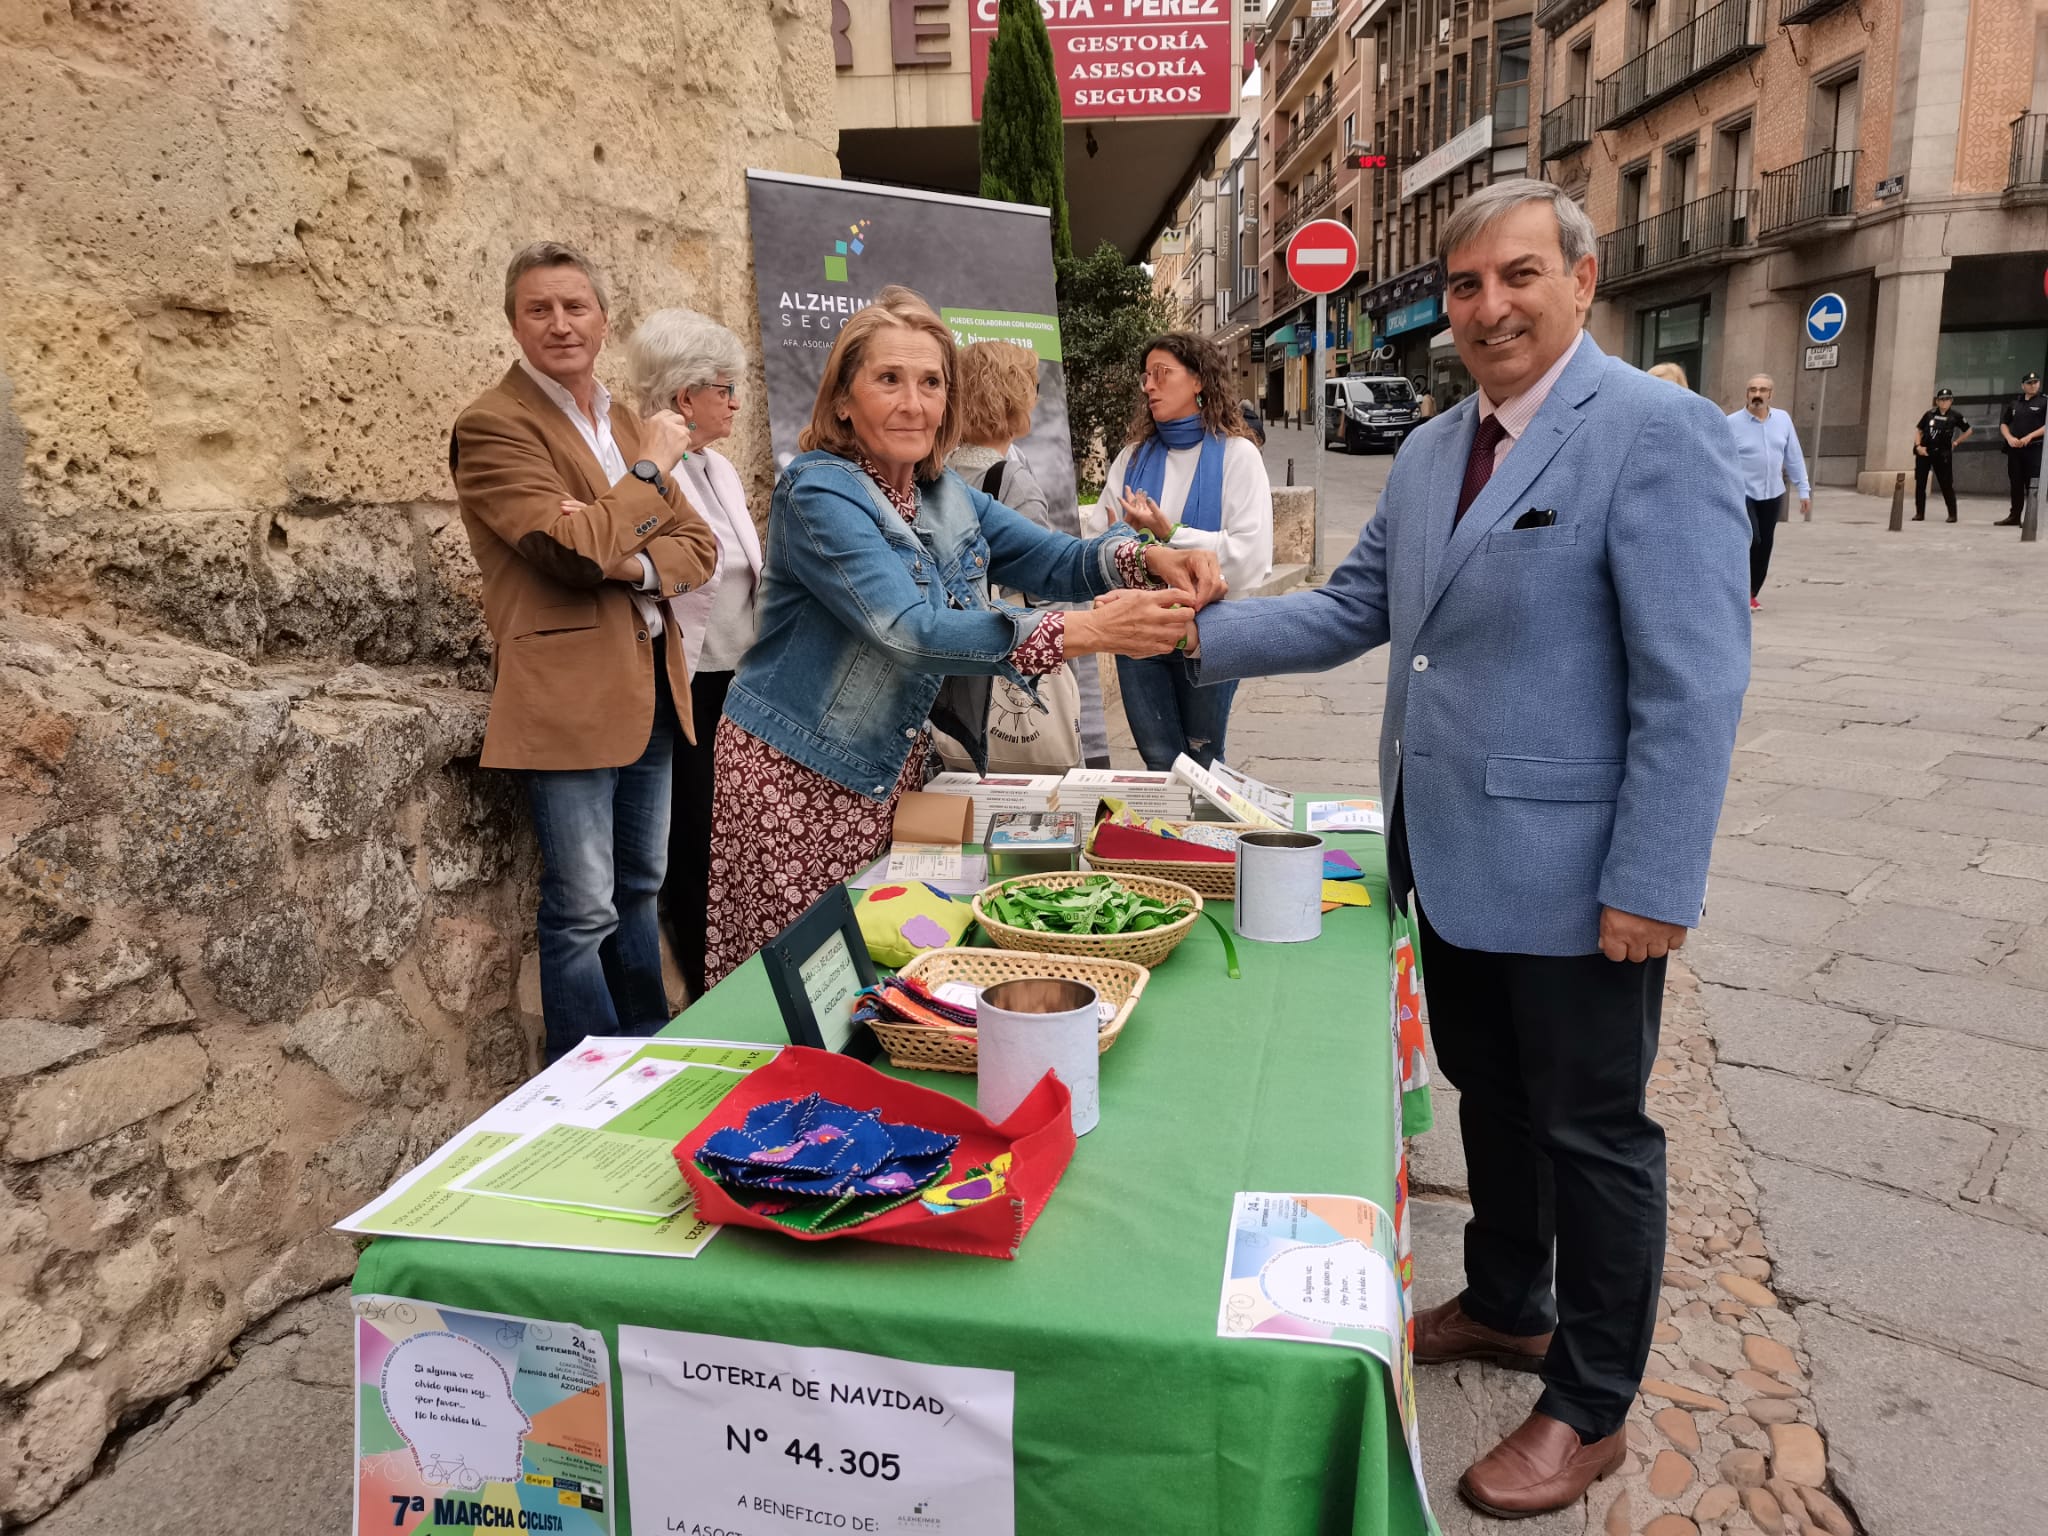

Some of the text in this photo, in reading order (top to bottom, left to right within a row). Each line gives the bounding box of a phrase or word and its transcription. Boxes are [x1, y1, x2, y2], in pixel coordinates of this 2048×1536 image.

[977, 0, 1094, 21] CSTA
[1067, 33, 1208, 53] GESTORÍA
[1069, 60, 1206, 80] ASESORÍA
[1074, 86, 1202, 106] SEGUROS
[779, 291, 875, 314] ALZHEIM
[950, 317, 974, 325] PUEDES
[974, 318, 1011, 328] COLABORAR
[1011, 320, 1025, 328] CON
[989, 726, 1040, 744] grateful heart
[535, 1345, 580, 1357] SEPTIEMBRE
[572, 1336, 586, 1350] 24
[414, 1364, 474, 1380] Si alguna vez
[519, 1368, 547, 1377] Avenida
[548, 1372, 560, 1380] del
[414, 1380, 441, 1391] olvido
[443, 1383, 469, 1395] quien
[560, 1382, 600, 1397] AZOGUEJO
[683, 1360, 944, 1415] LOTERIA DE NAVIDAD
[414, 1396, 434, 1407] Por
[414, 1410, 428, 1420] No
[429, 1412, 438, 1421] lo
[440, 1413, 469, 1425] olvides
[785, 1438, 901, 1481] 44.305
[434, 1498, 515, 1528] MARCHA
[518, 1510, 563, 1532] CICLISTA
[737, 1495, 879, 1532] A BENEFICIO DE:
[667, 1516, 742, 1536] LA ASO
